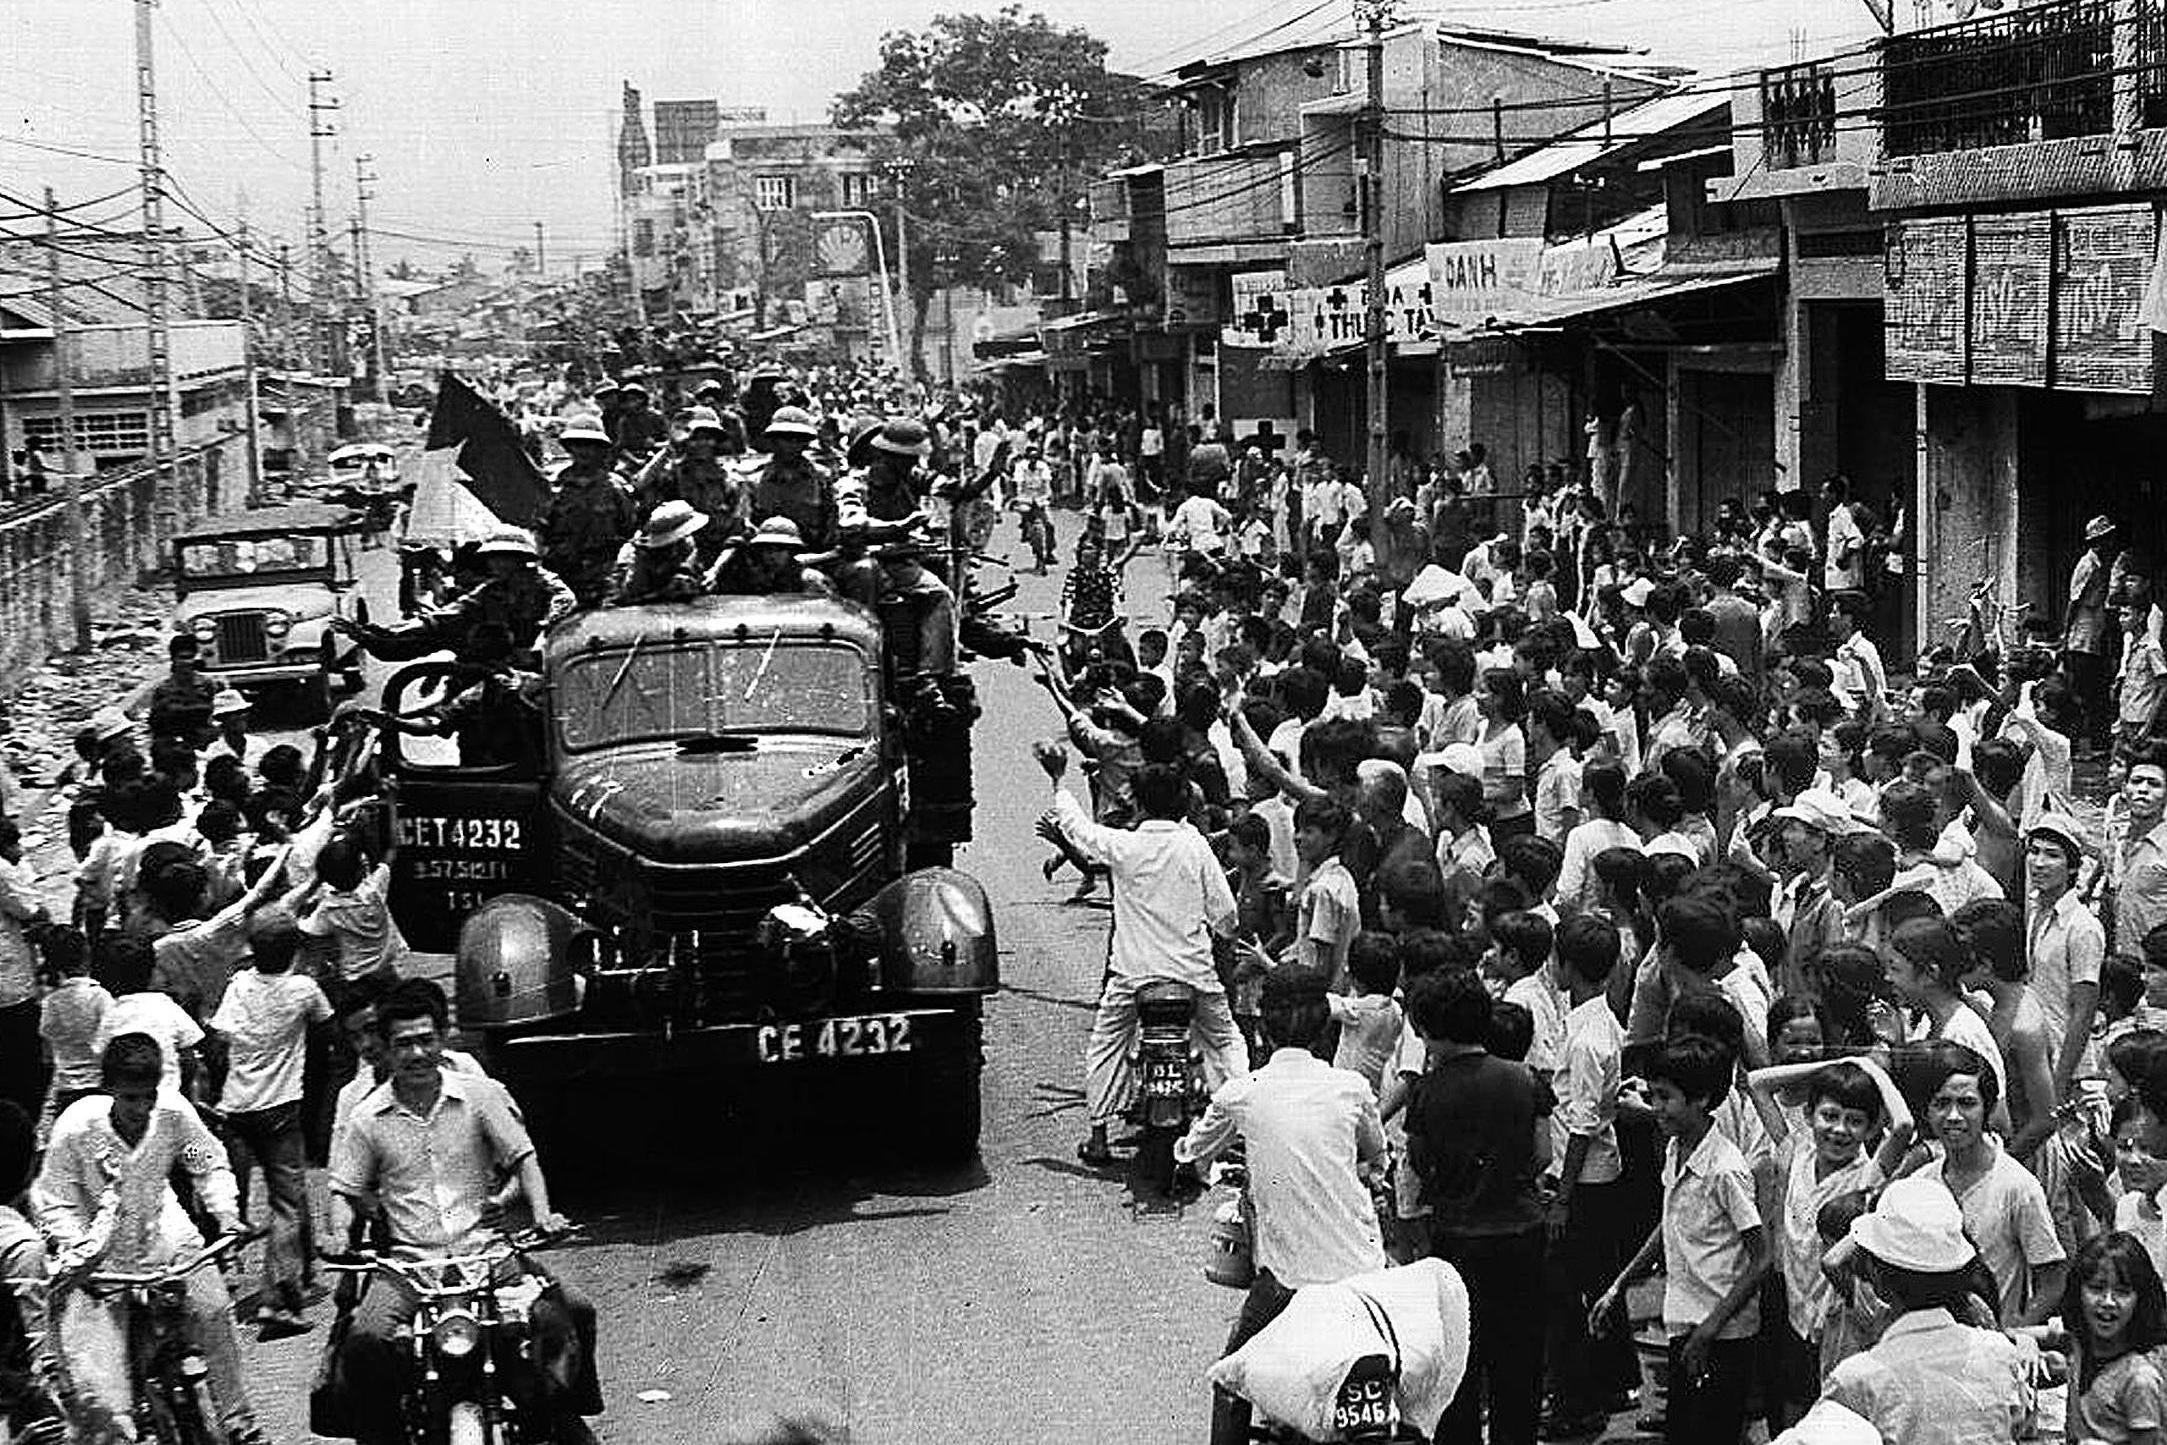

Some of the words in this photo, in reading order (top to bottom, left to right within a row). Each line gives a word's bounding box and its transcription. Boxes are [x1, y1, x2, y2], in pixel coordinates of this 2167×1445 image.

[1329, 310, 1395, 340] THUC
[758, 1024, 803, 1063] CE
[817, 1014, 911, 1057] 4232
